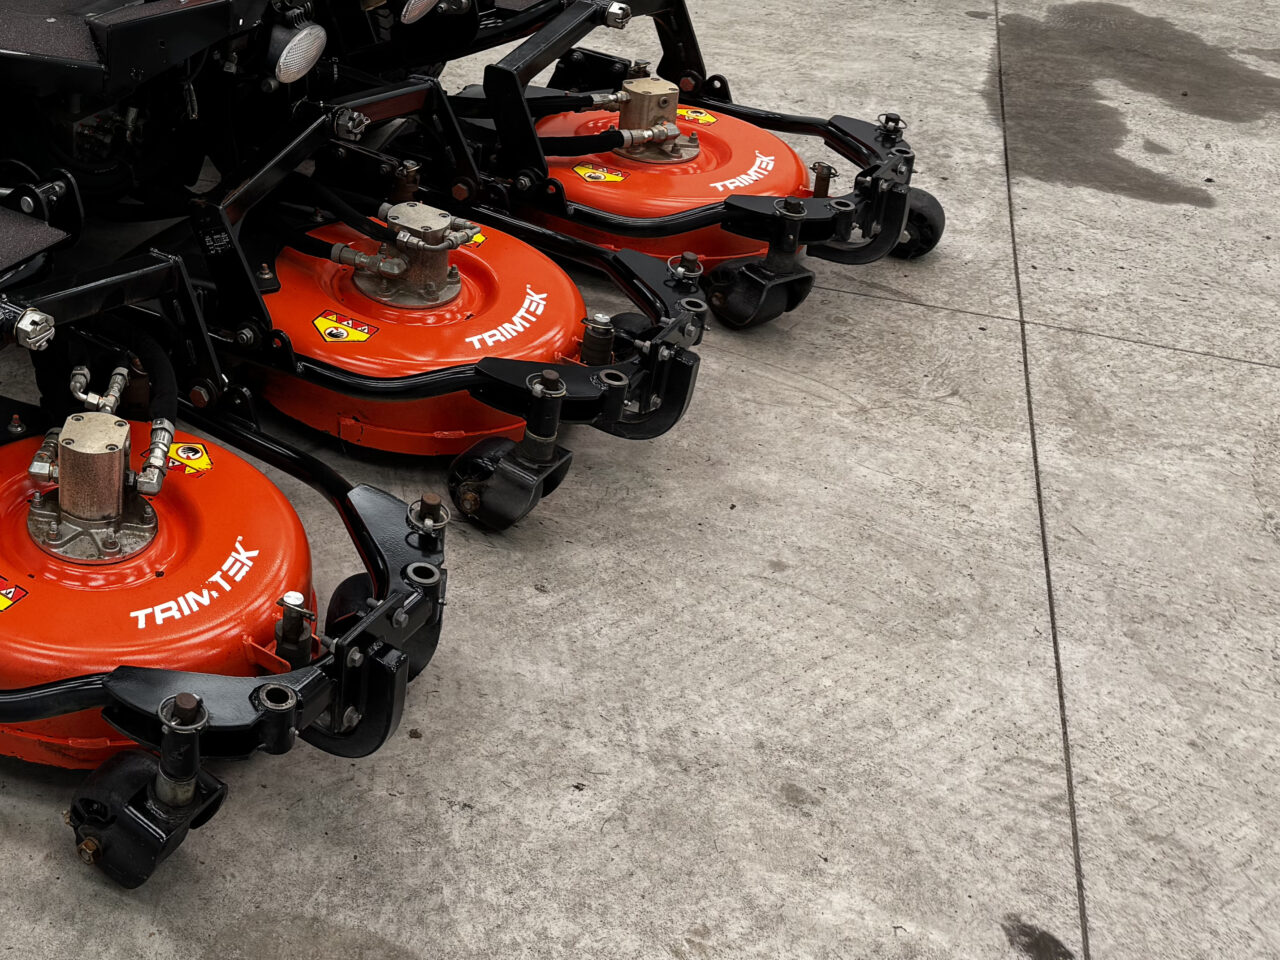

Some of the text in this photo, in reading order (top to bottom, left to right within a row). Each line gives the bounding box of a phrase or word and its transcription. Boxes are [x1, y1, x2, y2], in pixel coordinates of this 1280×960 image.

[709, 151, 775, 192] TRIMTEK
[465, 287, 548, 349] TRIMTEK
[129, 540, 260, 629] TRIMTEK
